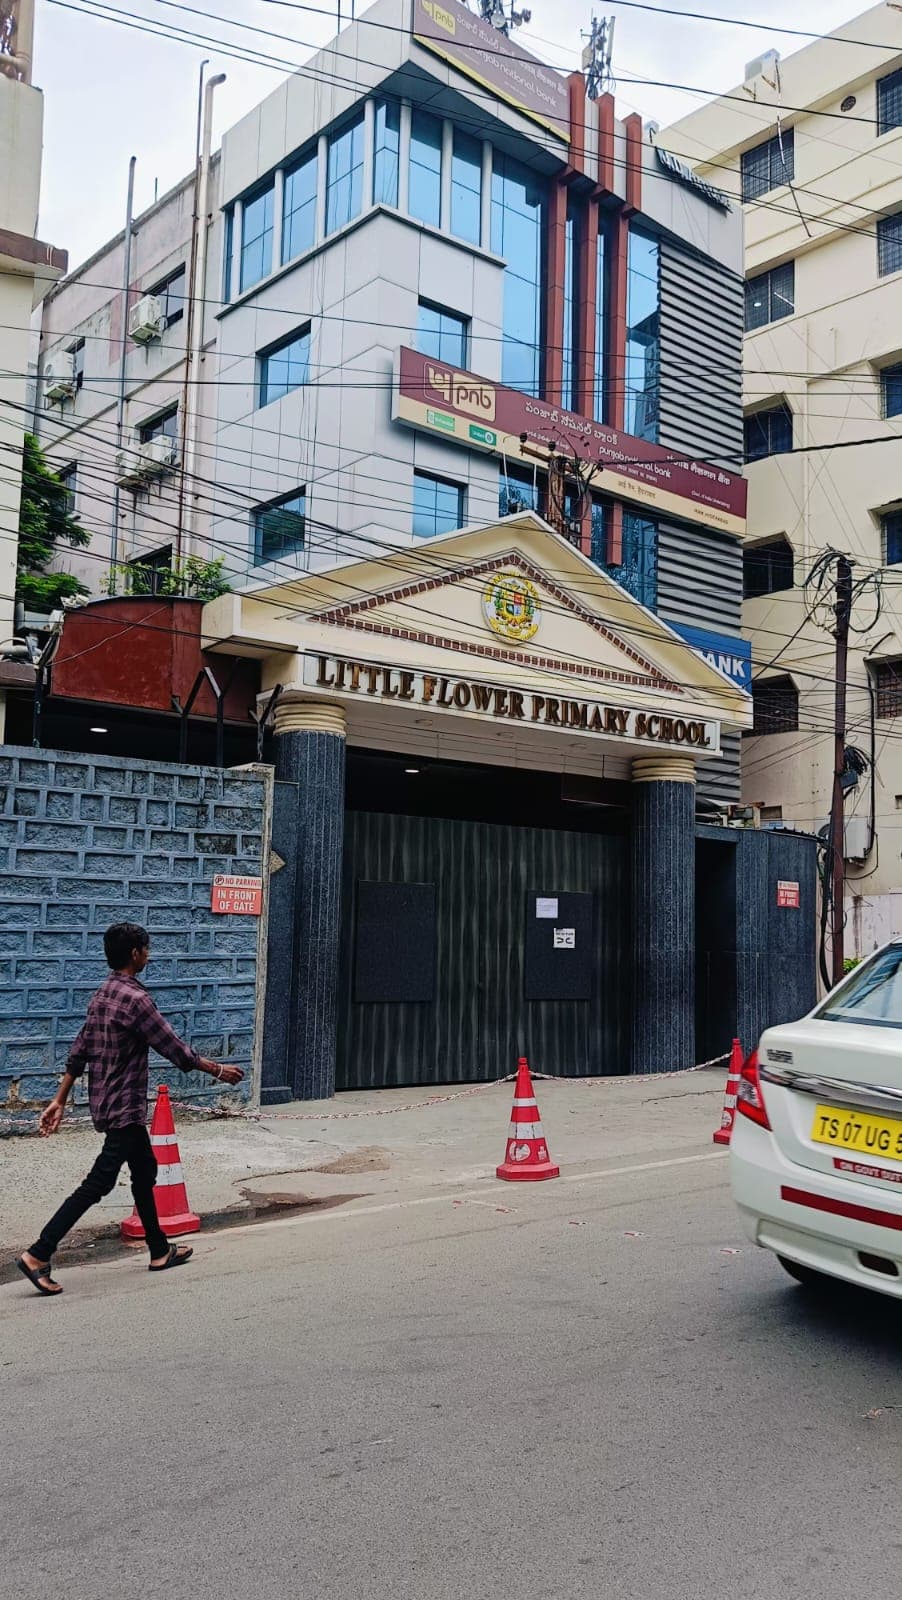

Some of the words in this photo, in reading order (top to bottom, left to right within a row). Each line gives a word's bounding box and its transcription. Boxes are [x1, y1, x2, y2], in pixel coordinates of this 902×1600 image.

[435, 10, 454, 28] pnb
[500, 65, 535, 91] national
[536, 89, 557, 106] bank
[456, 385, 492, 410] pnb
[525, 401, 559, 423] పంజాబ్
[599, 446, 625, 463] punjab
[654, 462, 672, 479] bank
[701, 651, 746, 679] ANK
[316, 655, 415, 700] LITTLE
[421, 674, 525, 719] FLOWER
[531, 694, 630, 733] PRIMARY
[635, 712, 711, 747] SCHOOL
[225, 877, 234, 885] NO
[217, 889, 226, 899] IN
[229, 890, 257, 901] FRONT
[219, 900, 230, 910] OF
[233, 901, 255, 911] GATE
[819, 1116, 840, 1139] TS
[842, 1121, 862, 1142] 07
[865, 1128, 891, 1151] UG
[854, 1165, 880, 1177] GOVT
